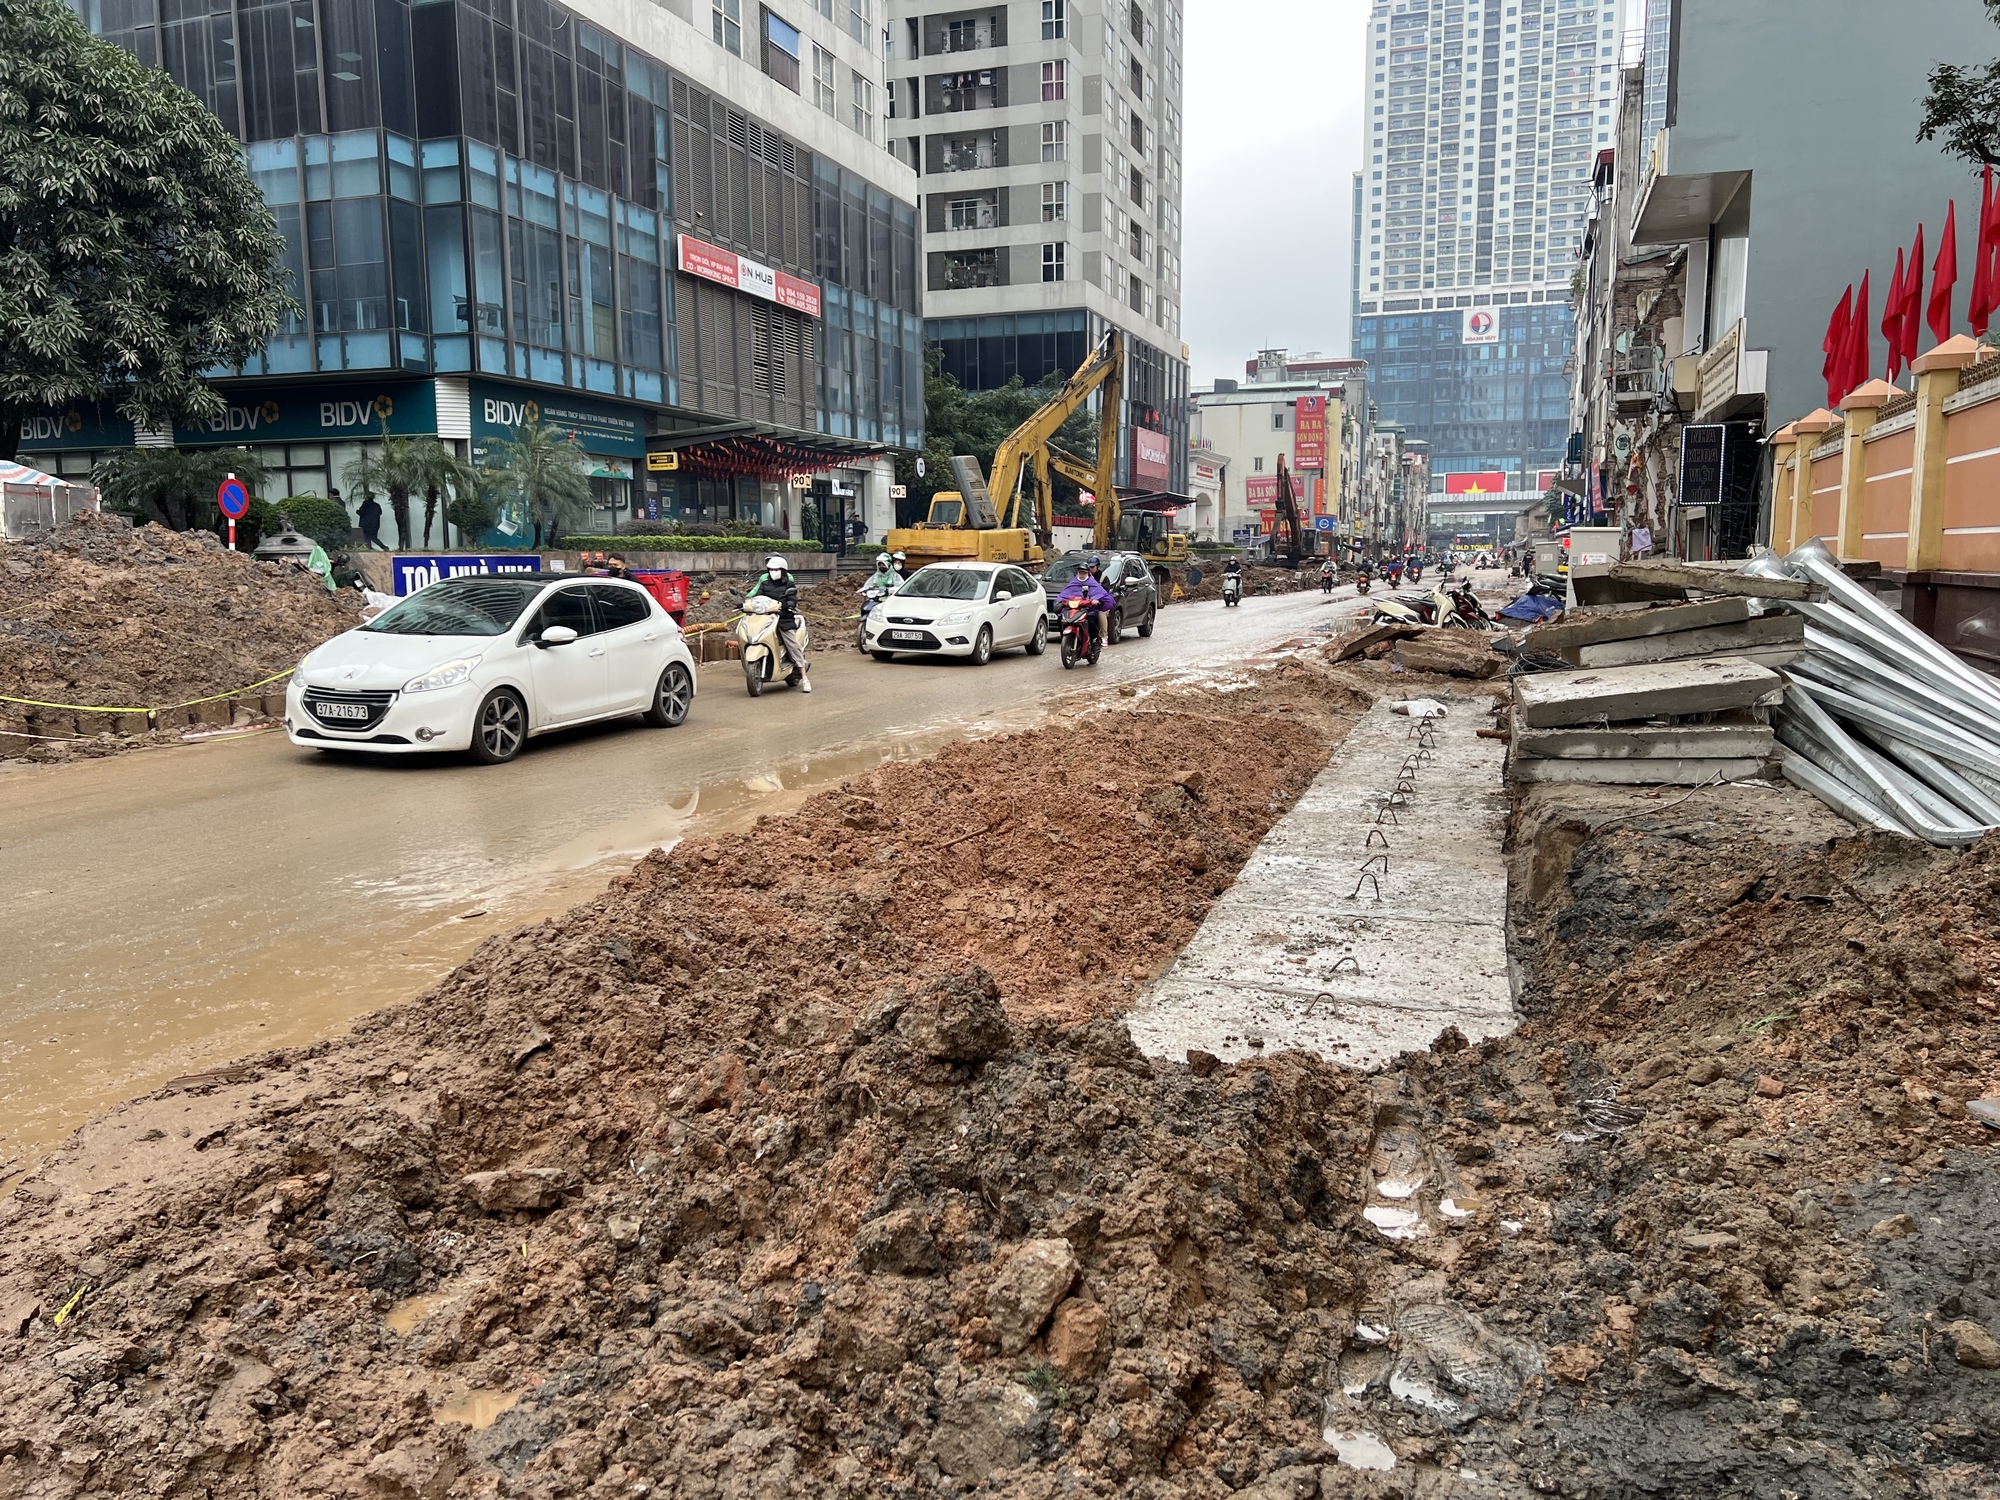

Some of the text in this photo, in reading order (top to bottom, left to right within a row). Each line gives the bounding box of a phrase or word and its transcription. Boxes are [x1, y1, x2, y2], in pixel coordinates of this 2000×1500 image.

[722, 273, 736, 285] SPACE
[755, 270, 773, 284] HUB
[211, 406, 261, 431] BIDV
[320, 401, 374, 426] BIDV
[484, 398, 525, 426] BIDV
[21, 416, 65, 440] BIDV
[1300, 419, 1322, 430] BA BA
[1690, 429, 1716, 443] NHA
[1686, 448, 1718, 462] KHOA
[794, 476, 804, 485] 90
[1689, 464, 1714, 485] VIỆT
[1248, 487, 1256, 498] BA
[1257, 486, 1265, 497] BA
[1691, 485, 1711, 501] TÍN
